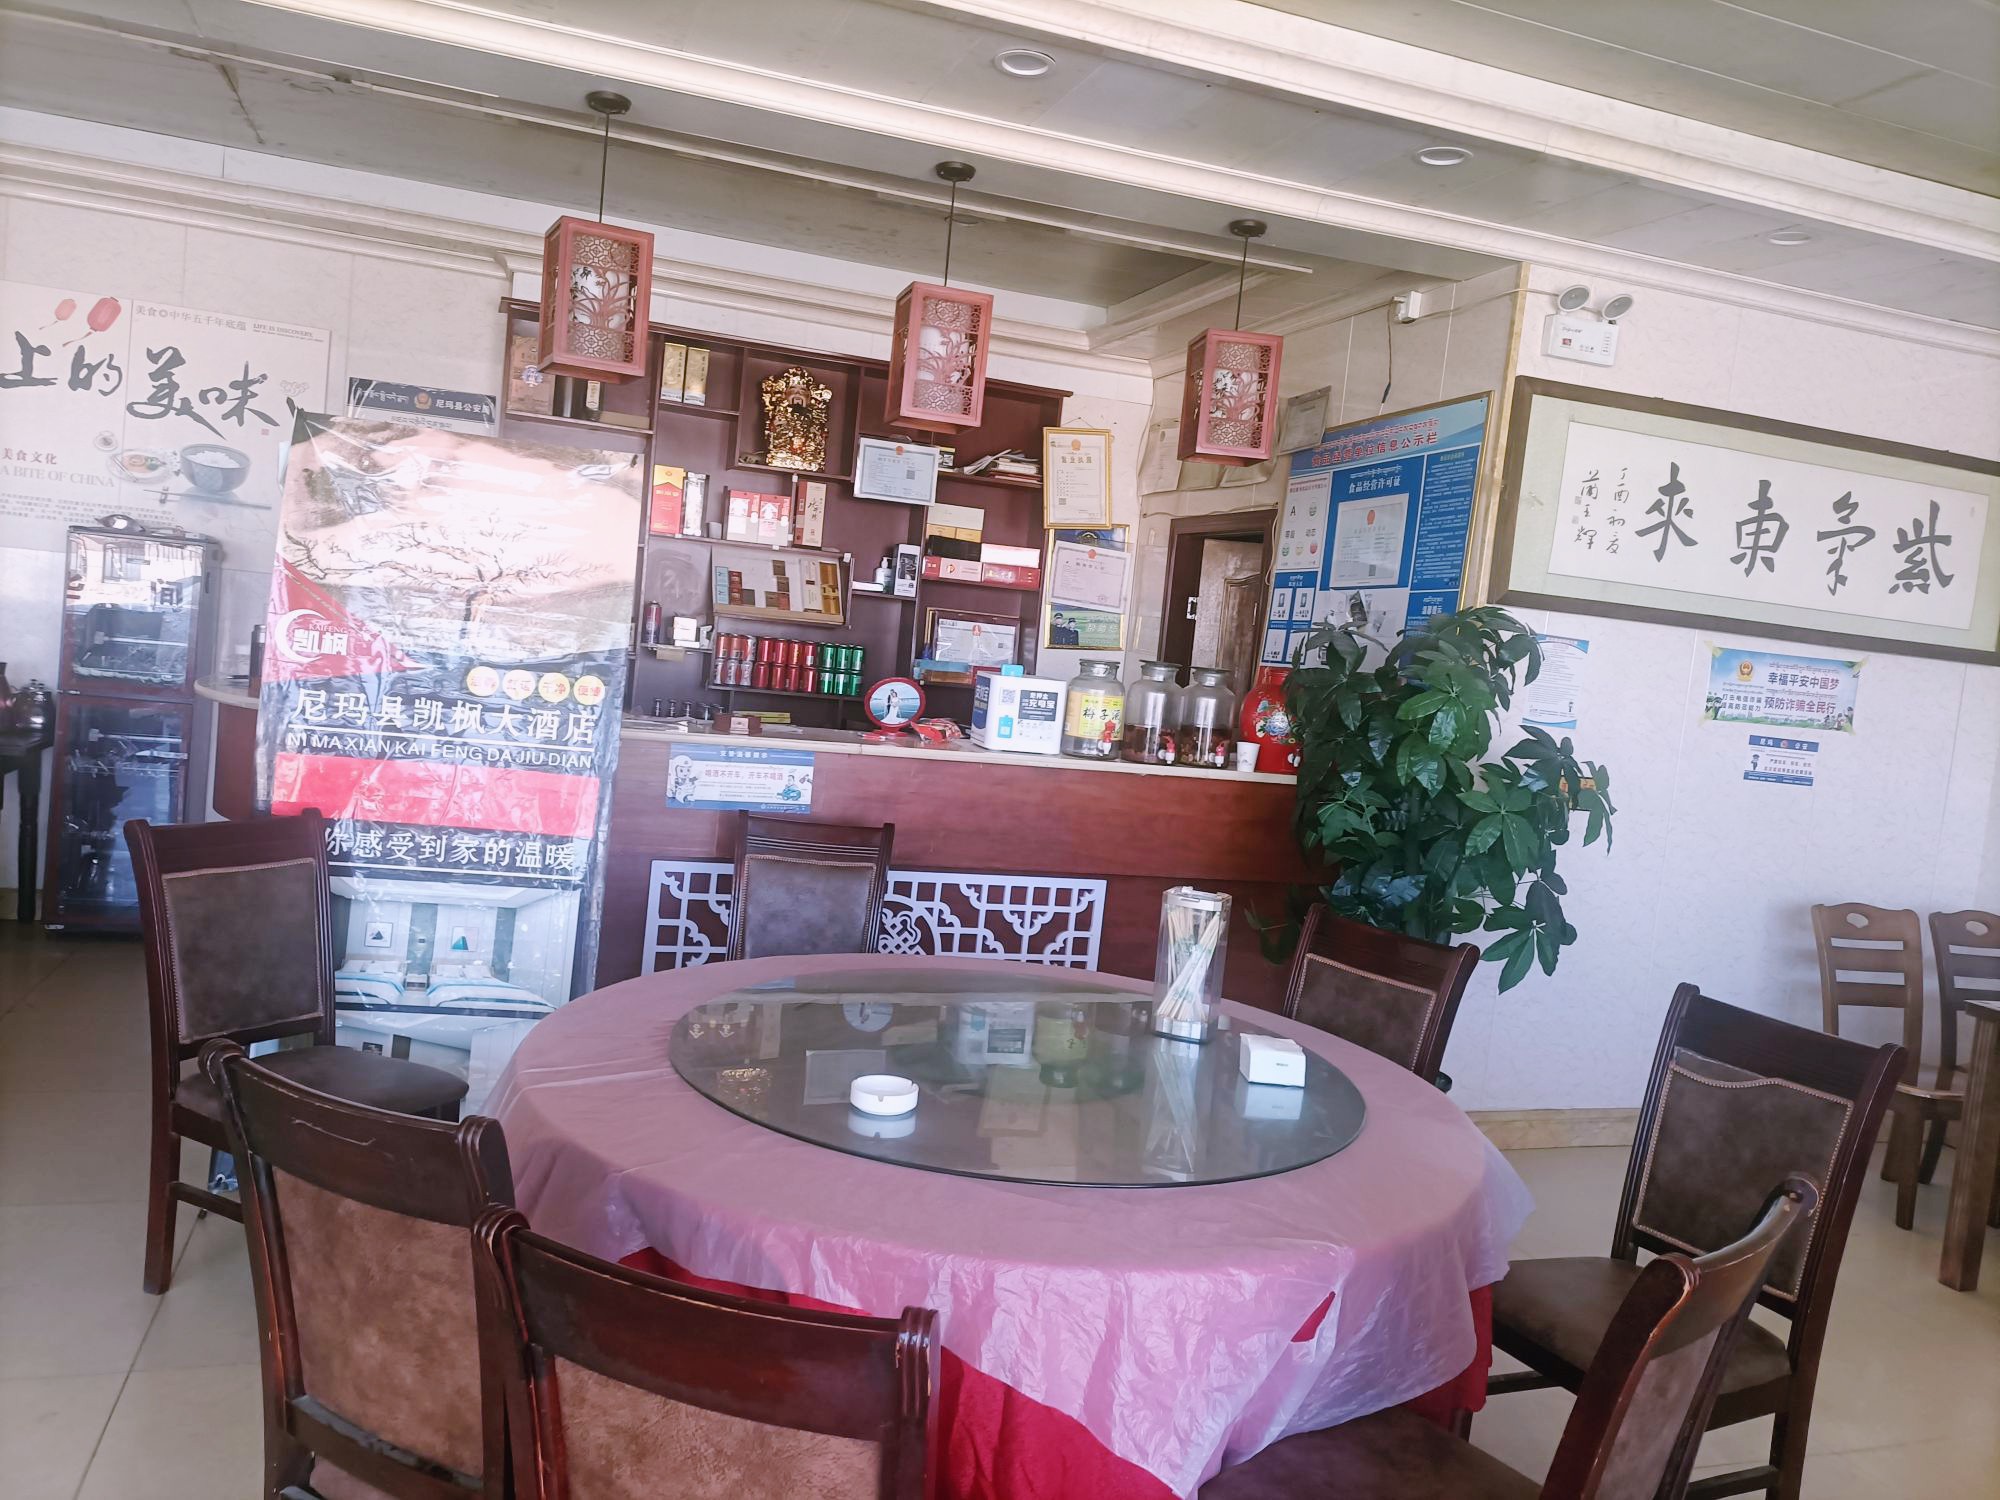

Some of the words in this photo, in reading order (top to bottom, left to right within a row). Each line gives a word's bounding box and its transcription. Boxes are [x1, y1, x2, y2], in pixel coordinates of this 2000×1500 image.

[2, 447, 58, 465] 美食文化
[14, 466, 45, 478] BITE
[48, 471, 64, 482] OF
[70, 473, 115, 488] CHINA
[1348, 476, 1401, 494] 食品经营许可证
[292, 629, 348, 656] 凯枫
[1768, 672, 1840, 690] 幸福平安中国梦
[1764, 696, 1837, 715] 预防诈骗全民行
[292, 689, 599, 744] 尼玛县凯枫大酒店
[313, 735, 341, 750] MA
[346, 737, 392, 754] XIAN
[395, 741, 426, 756] KAI
[432, 743, 482, 761] FENG
[487, 749, 513, 763] DA
[515, 750, 545, 765] JIU
[548, 753, 592, 768] DIAN
